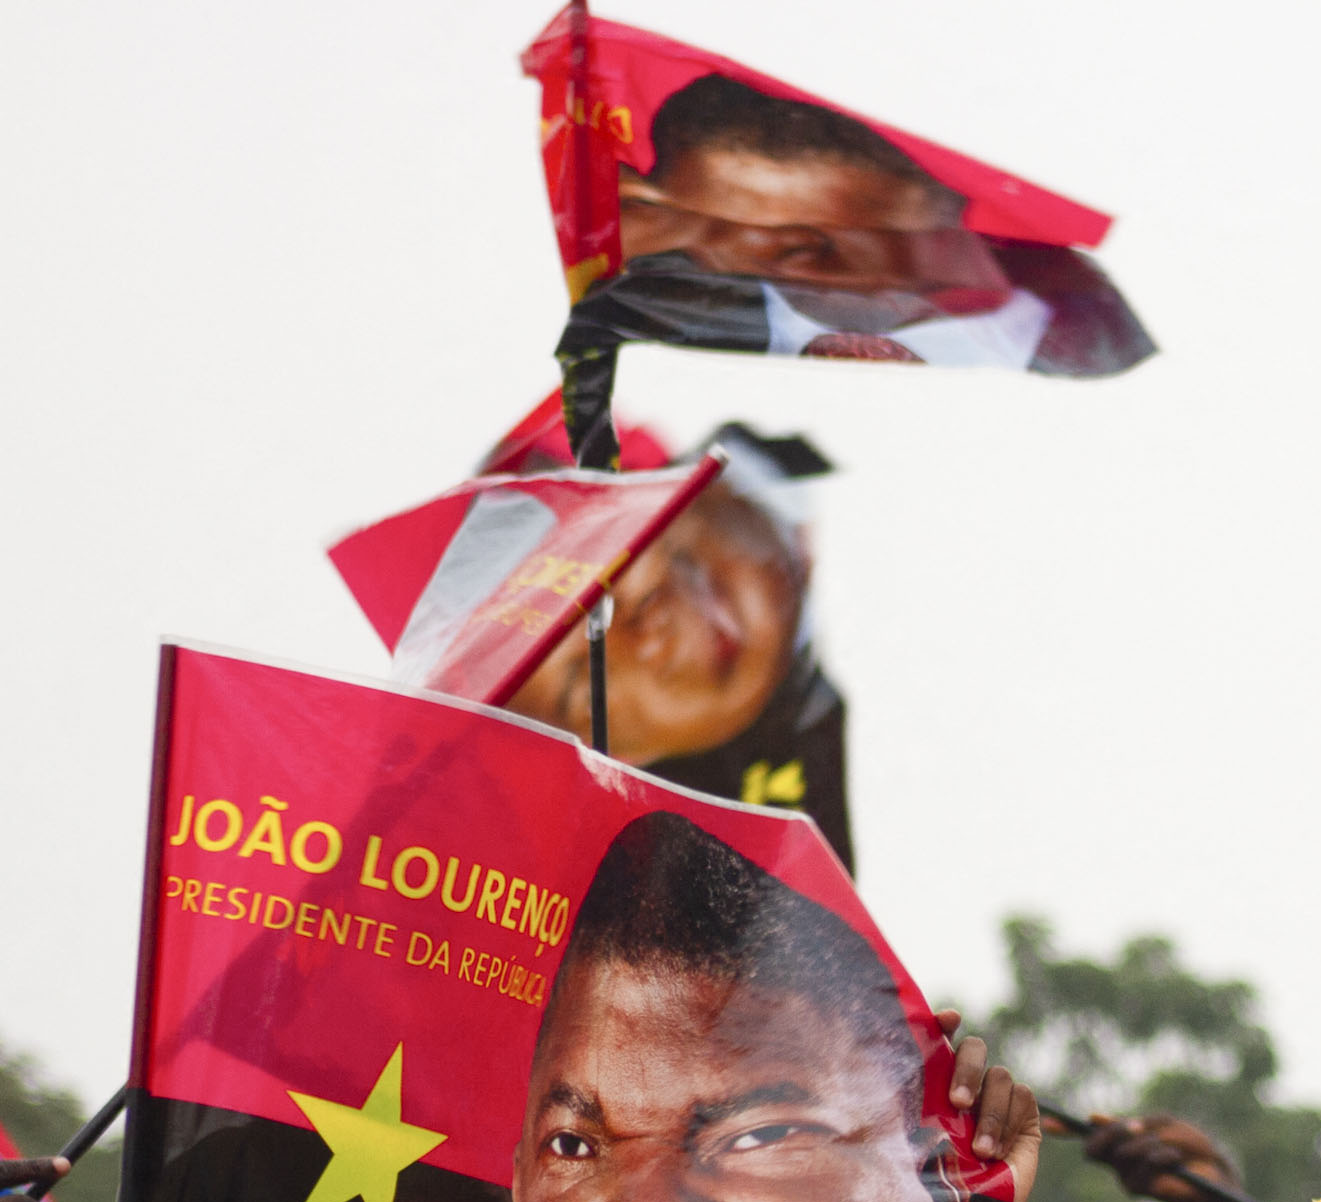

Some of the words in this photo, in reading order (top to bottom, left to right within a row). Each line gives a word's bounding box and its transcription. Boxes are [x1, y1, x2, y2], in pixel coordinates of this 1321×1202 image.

[171, 795, 343, 874] JOÃO
[360, 834, 571, 958] LOURENÇO
[405, 931, 451, 975] DA
